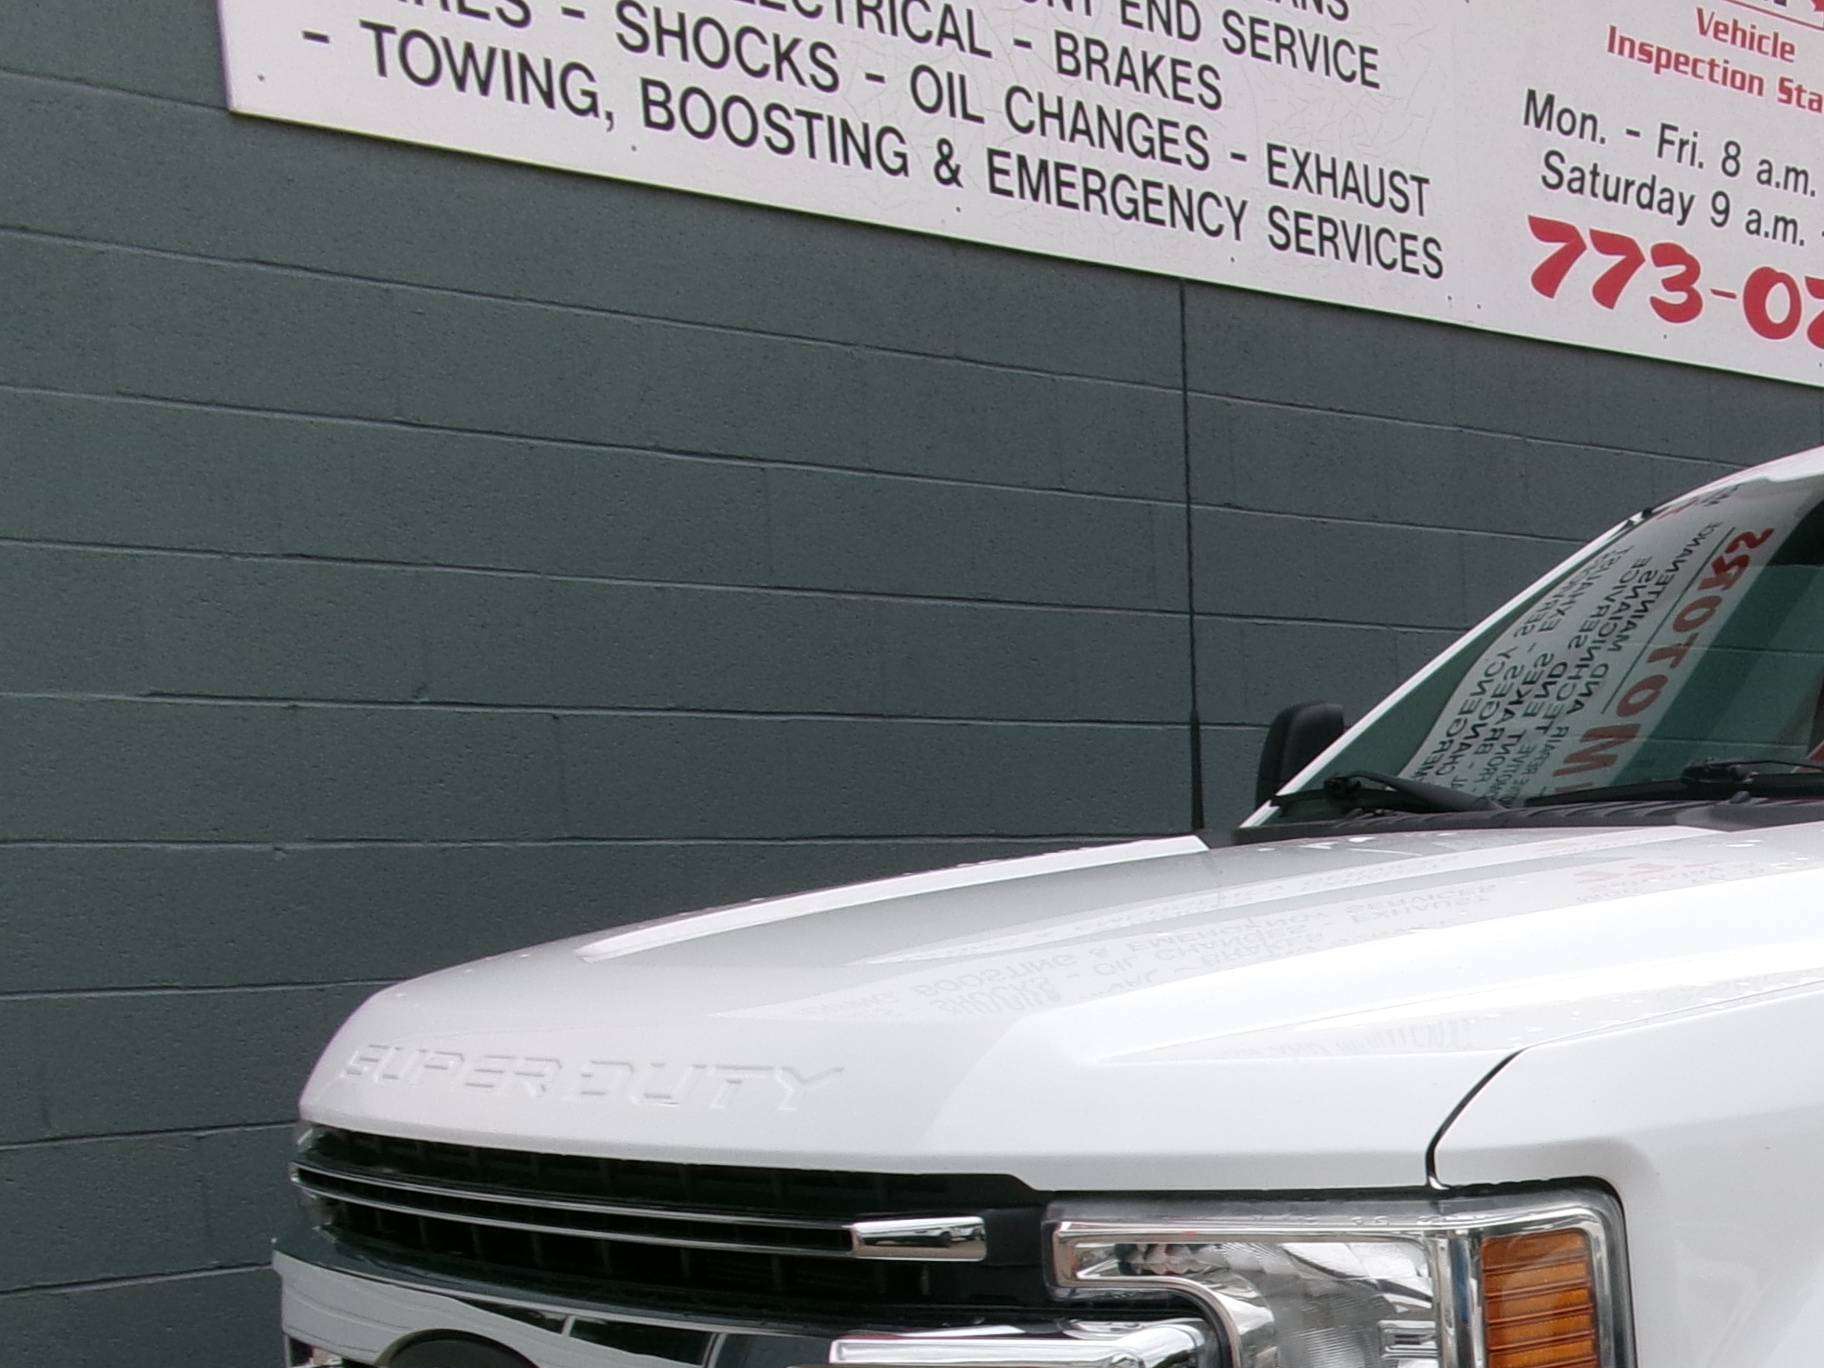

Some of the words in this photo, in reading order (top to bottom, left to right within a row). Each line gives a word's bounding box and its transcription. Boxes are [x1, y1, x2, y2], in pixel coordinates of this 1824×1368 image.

[1054, 30, 1222, 111] BRAKES
[1223, 10, 1380, 89] SERVICE
[1607, 25, 1764, 97] Inspection
[1697, 7, 1795, 63] Vehicle
[615, 0, 840, 94] SHOCKS
[911, 65, 985, 125] OIL
[1005, 86, 1210, 172] CHANGES
[1266, 143, 1430, 217] EXHAUST
[1523, 88, 1606, 145] Mon.
[1657, 122, 1704, 169] Fri.
[1721, 140, 1741, 178] 8
[1756, 158, 1816, 197] a.m.
[360, 20, 614, 132] TOWING,
[640, 78, 909, 178] BOOSTING
[933, 137, 964, 189] &
[987, 147, 1248, 242] EMERGENCY
[1267, 205, 1444, 280] SERVICES
[1541, 149, 1695, 227] Saturday
[1710, 190, 1731, 228] 9
[1745, 208, 1806, 247] a.m.
[343, 1043, 563, 1100] SUPER
[577, 1056, 845, 1112] DUTY
